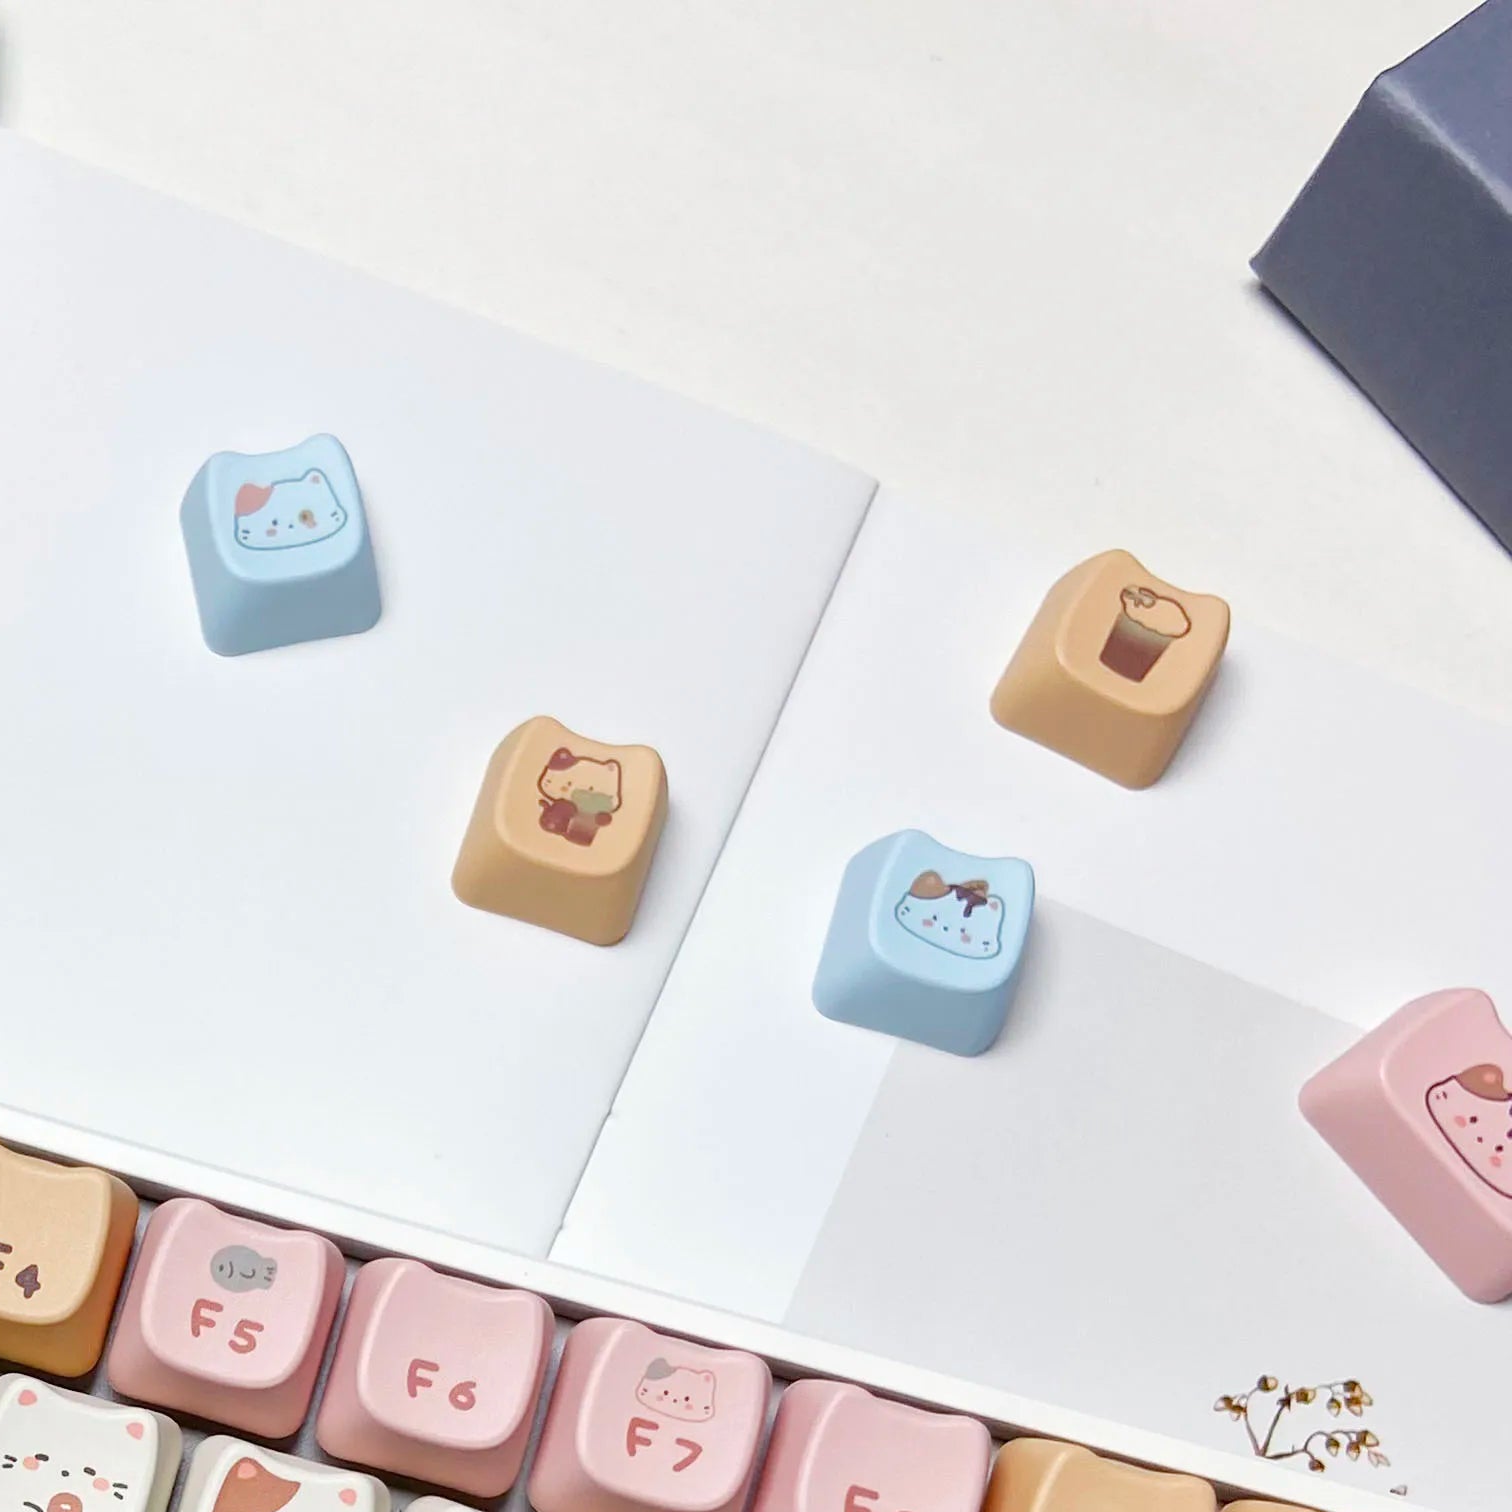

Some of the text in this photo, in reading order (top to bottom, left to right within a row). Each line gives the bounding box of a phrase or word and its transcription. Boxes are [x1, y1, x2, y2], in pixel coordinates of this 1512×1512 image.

[190, 1298, 265, 1354] F5
[407, 1359, 476, 1411] F6
[626, 1417, 702, 1472] F7
